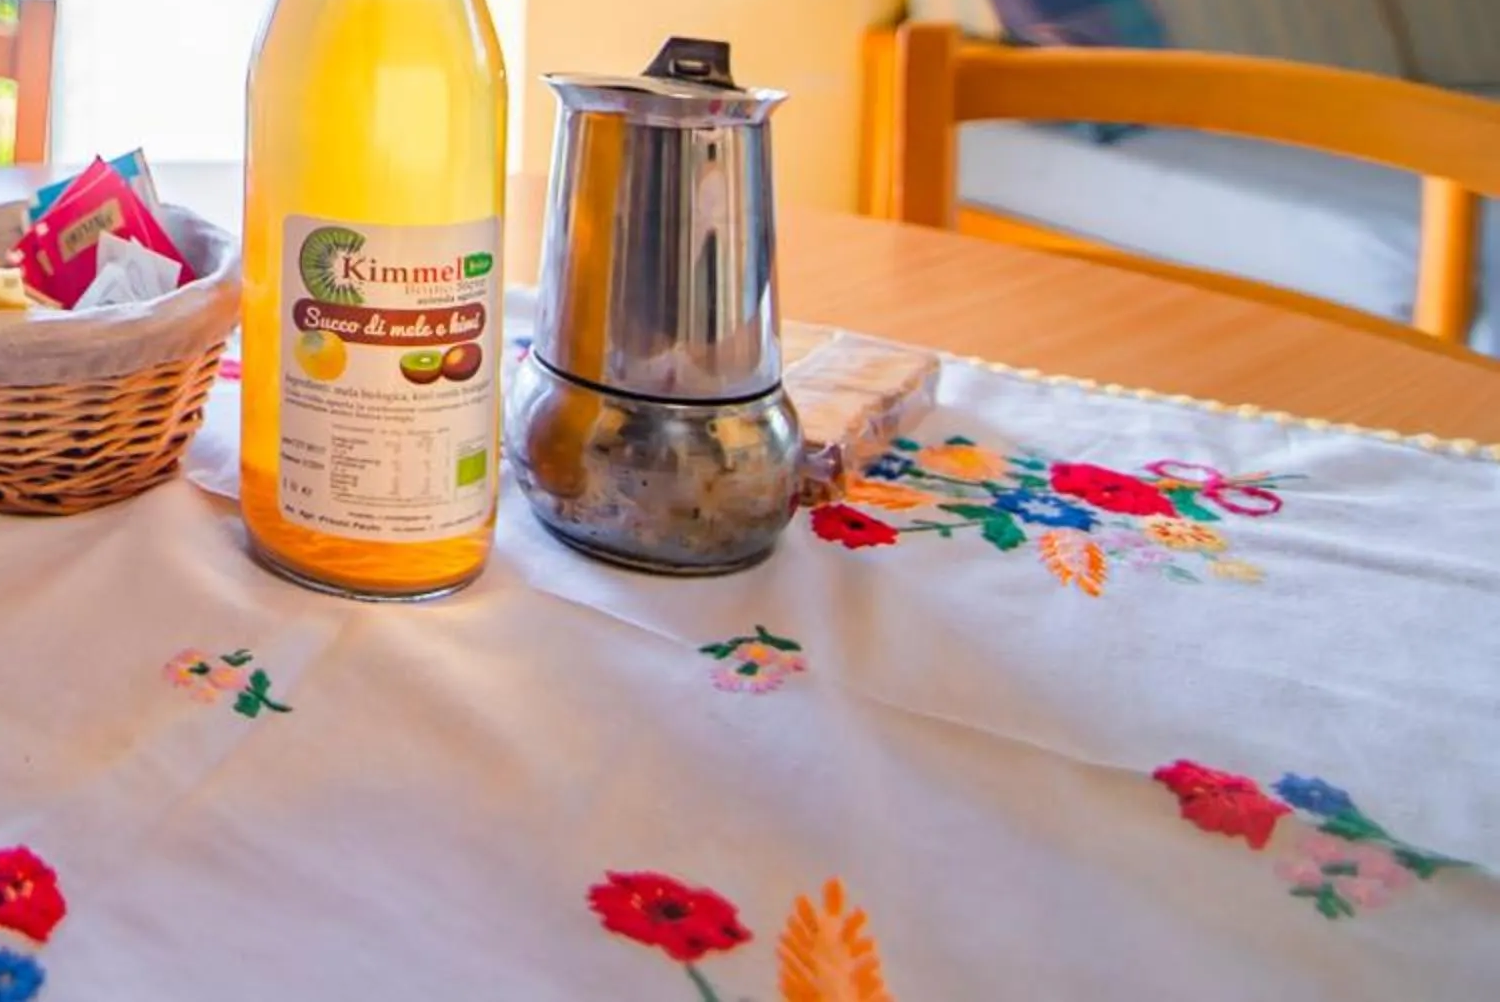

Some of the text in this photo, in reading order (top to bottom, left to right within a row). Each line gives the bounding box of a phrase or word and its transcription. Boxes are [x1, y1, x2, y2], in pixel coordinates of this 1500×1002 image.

[342, 255, 462, 283] Kimmel
[304, 307, 360, 334] Succo
[363, 314, 386, 336] di
[389, 315, 434, 337] mele
[435, 323, 446, 336] e
